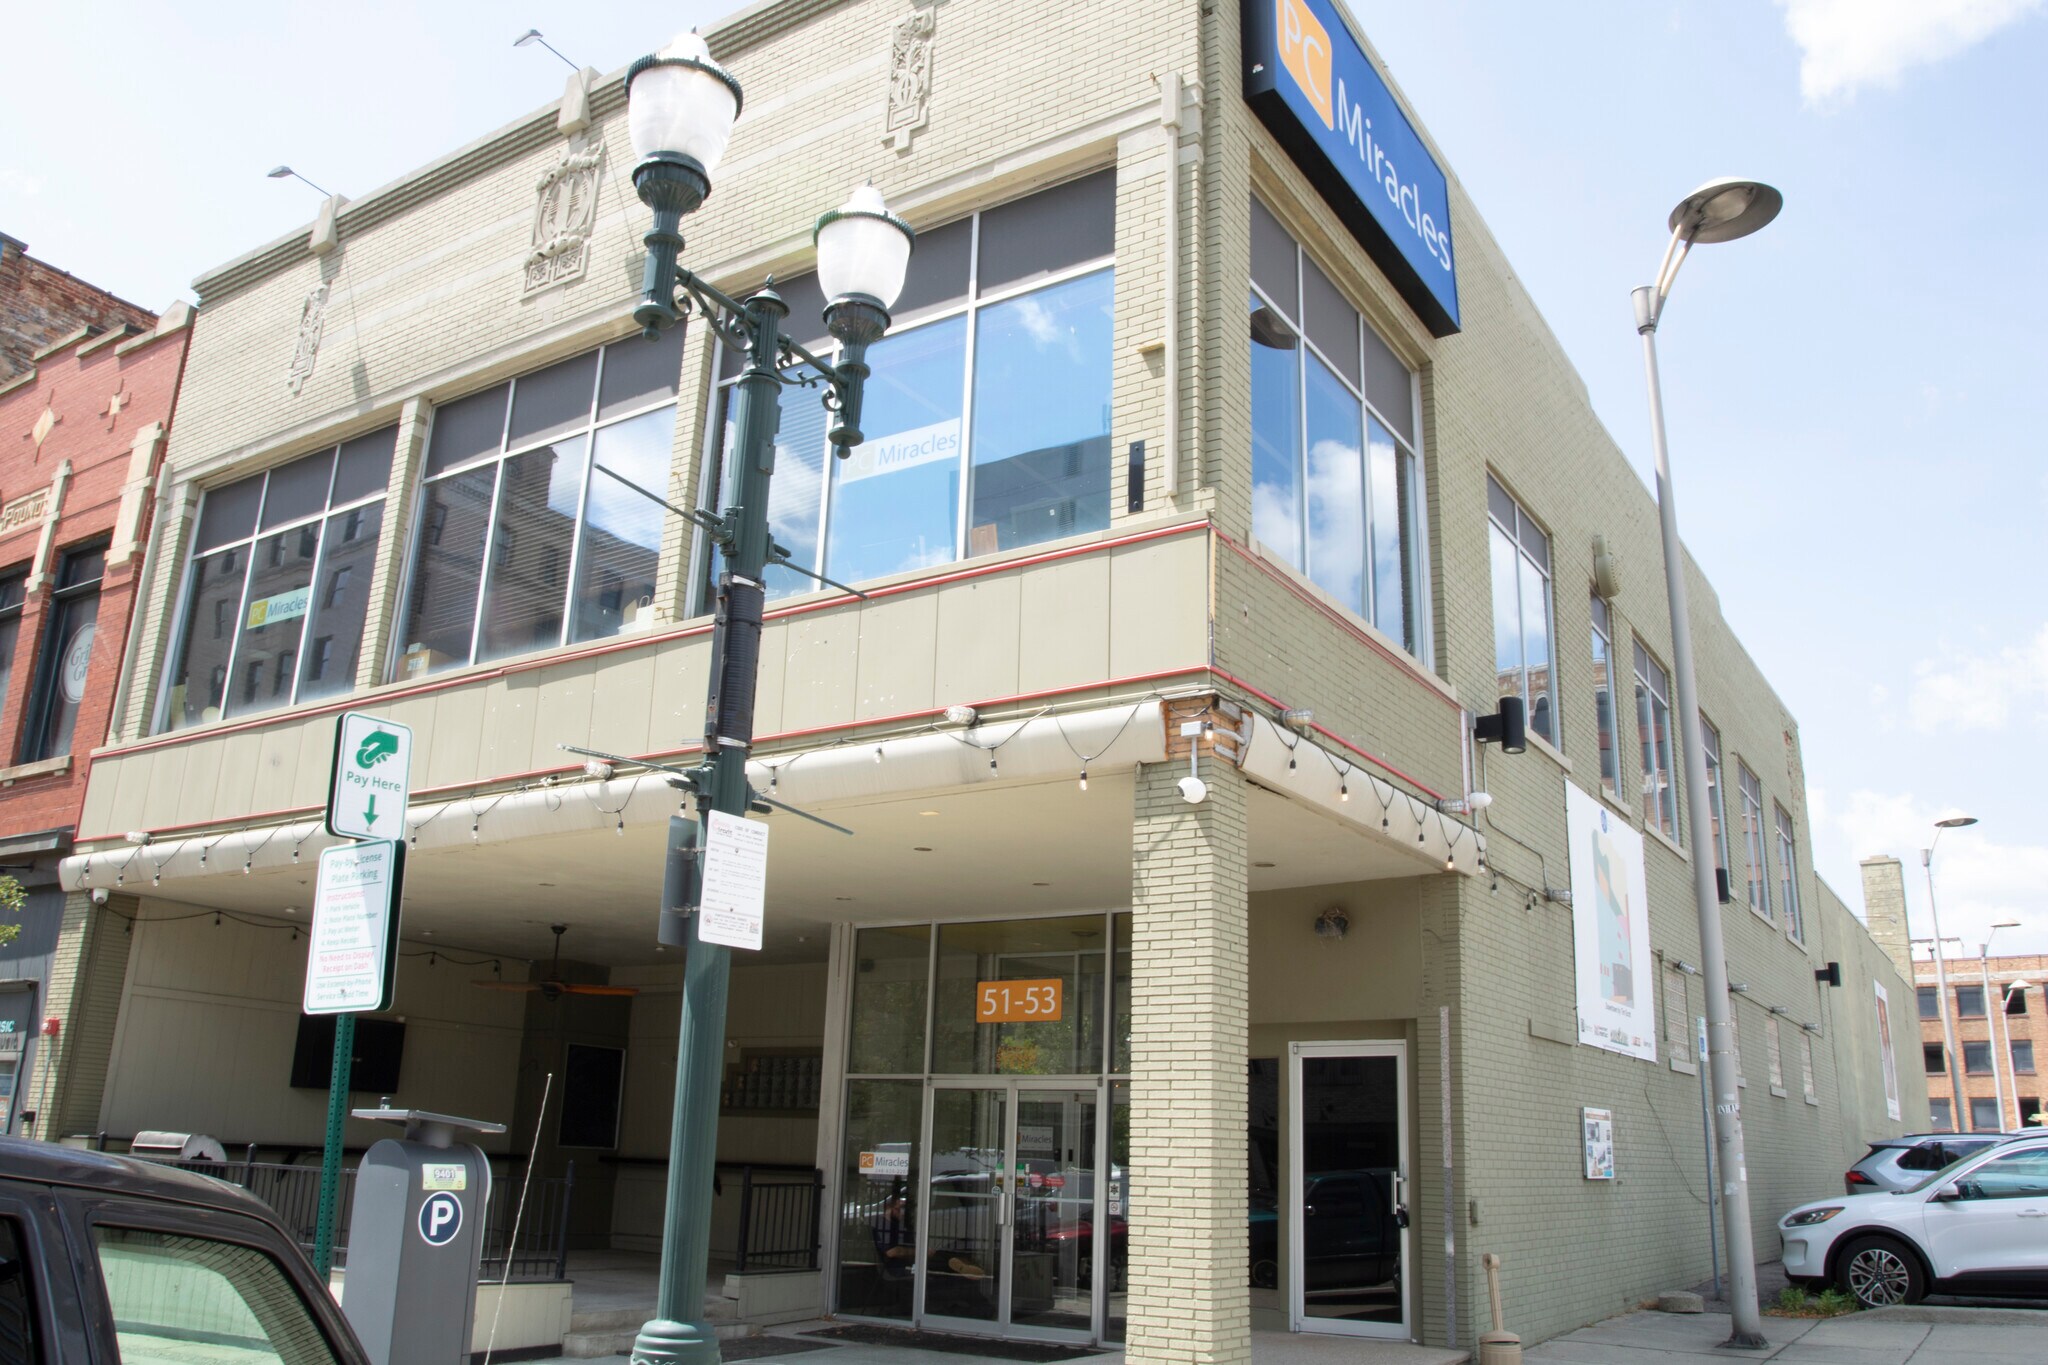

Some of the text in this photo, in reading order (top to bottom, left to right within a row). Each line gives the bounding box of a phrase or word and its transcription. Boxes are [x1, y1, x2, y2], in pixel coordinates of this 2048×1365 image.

[1283, 0, 1451, 272] PC Miracles
[877, 433, 957, 466] Miracles
[267, 596, 309, 618] Miracles
[346, 771, 401, 792] Pay Here
[331, 869, 378, 883] Plate Parking
[982, 986, 1056, 1016] 51-53
[0, 1020, 15, 1032] SIC
[1021, 1134, 1052, 1144] Miracles
[861, 1156, 909, 1167] PC Miracles
[433, 1168, 456, 1179] 9401
[429, 1200, 455, 1237] P
